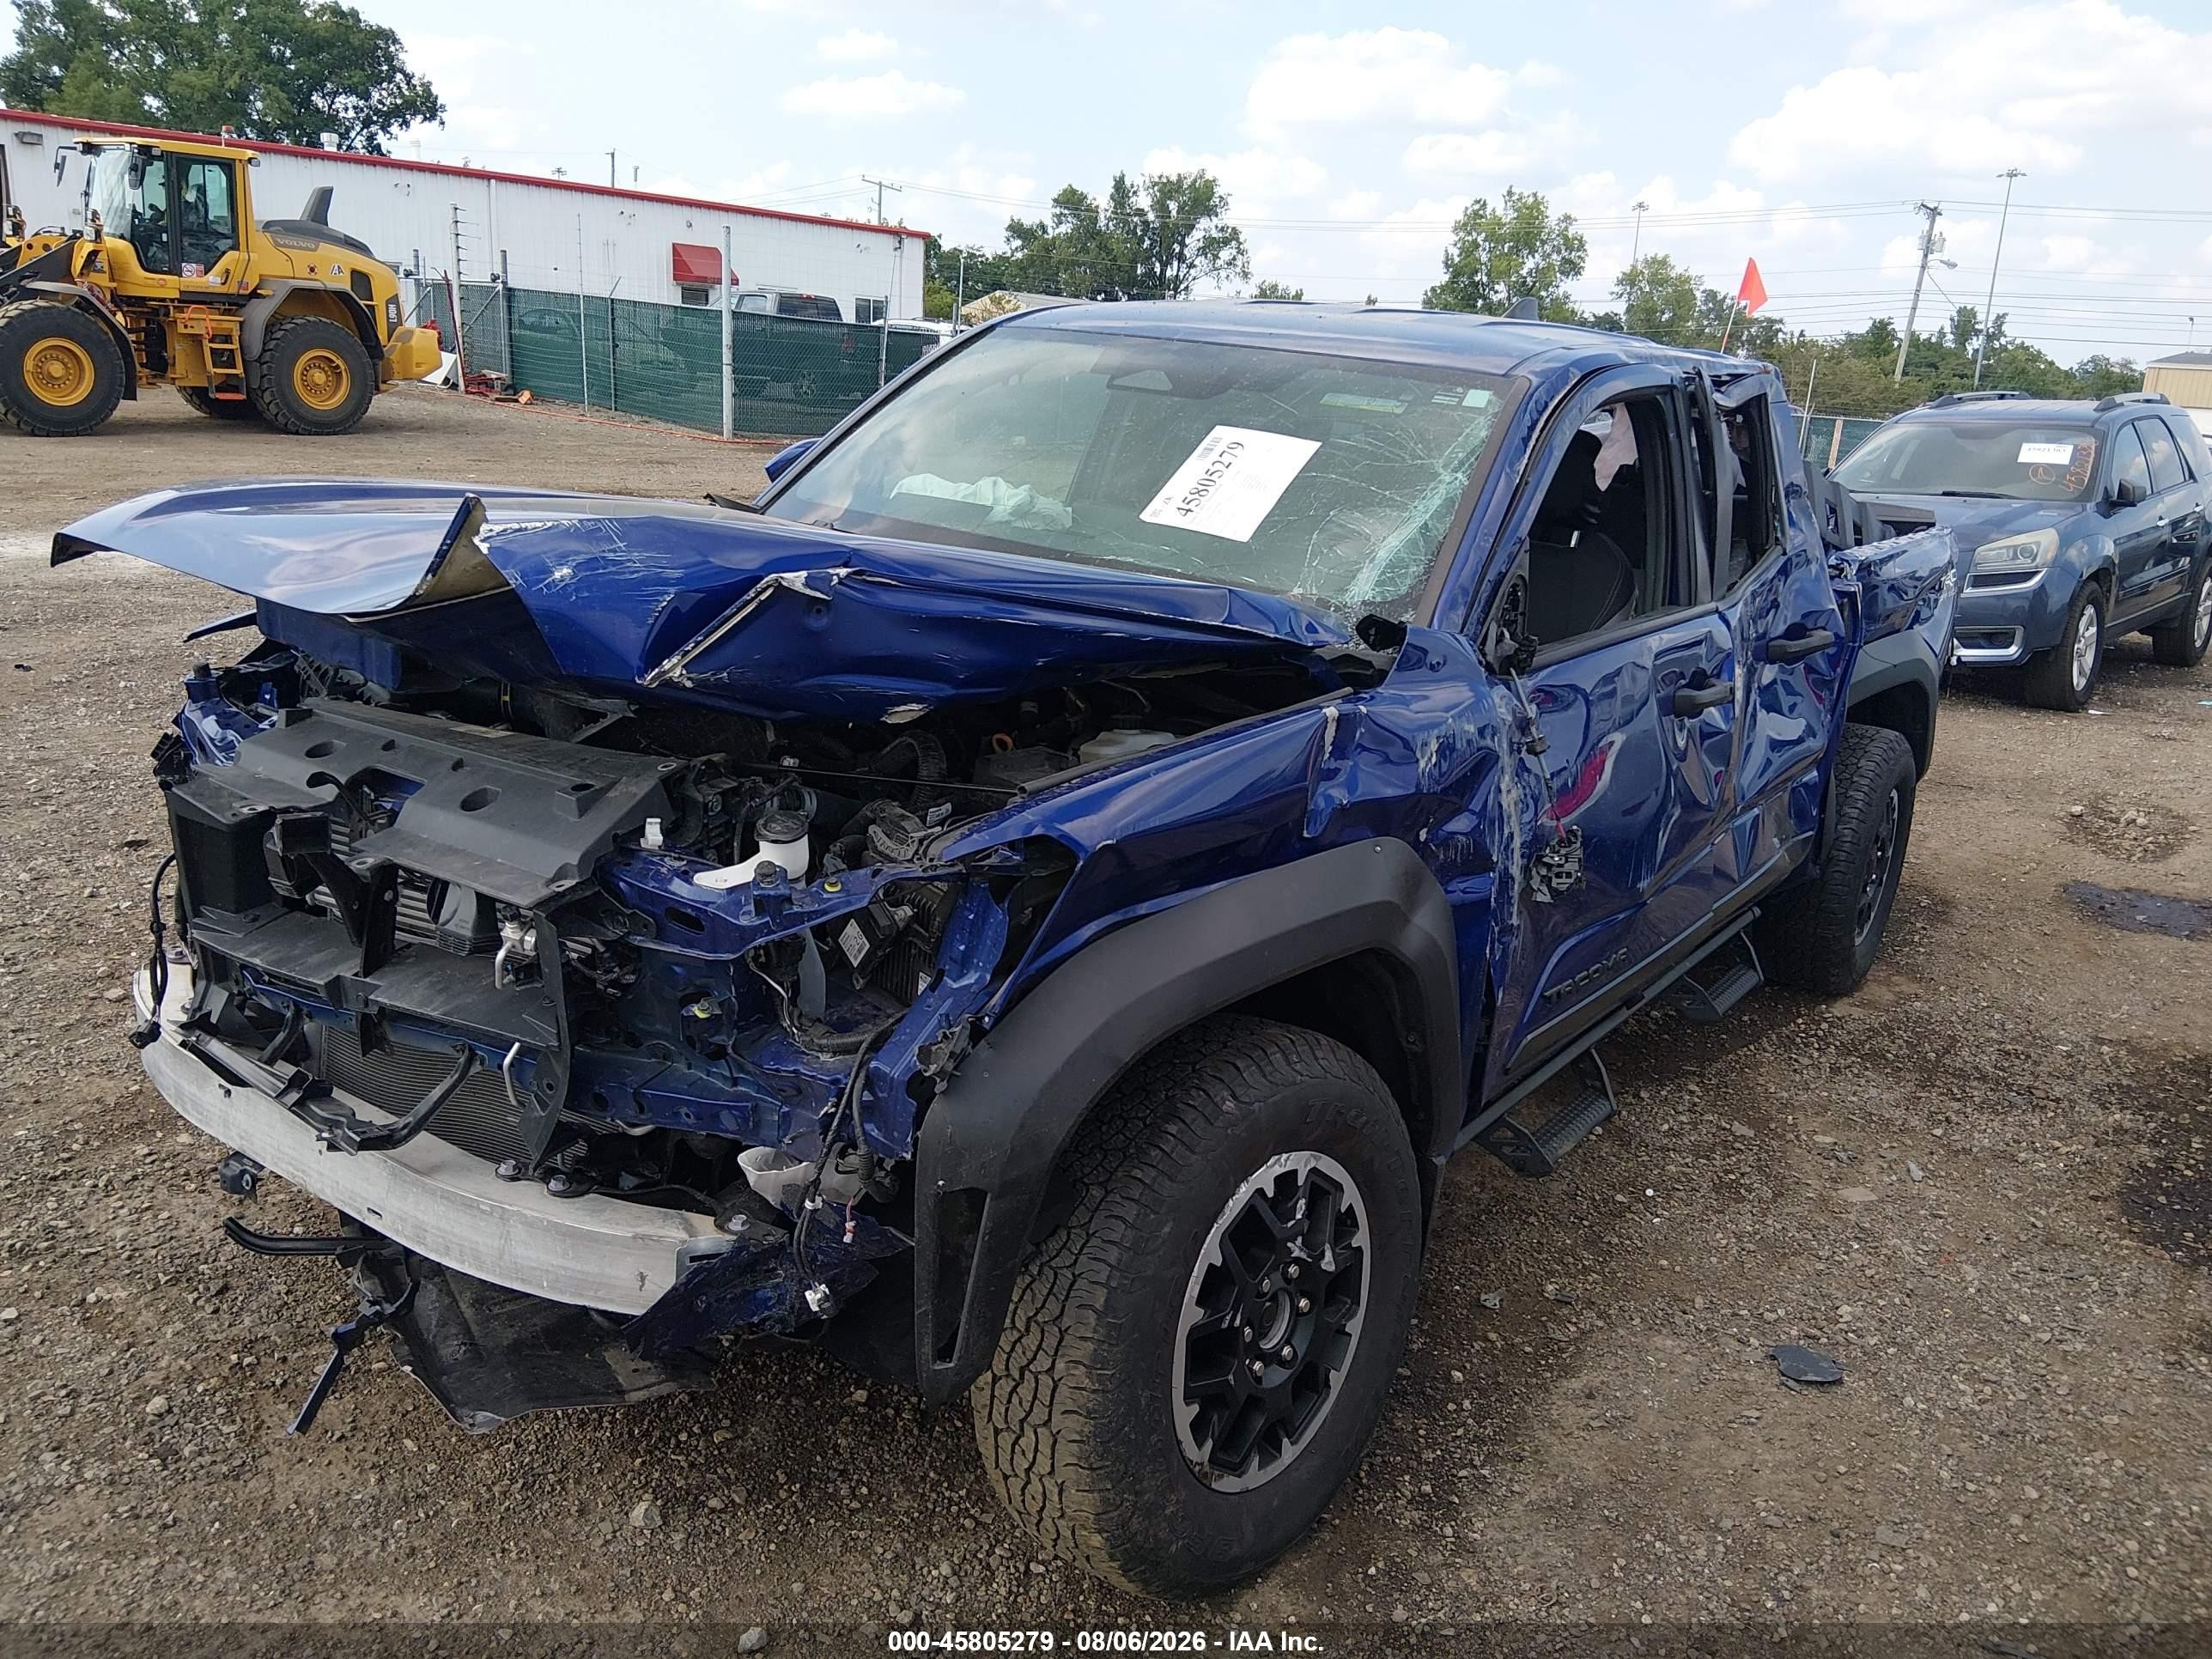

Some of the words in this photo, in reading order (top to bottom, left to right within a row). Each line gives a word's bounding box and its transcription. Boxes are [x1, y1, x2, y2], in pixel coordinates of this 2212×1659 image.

[276, 239, 316, 249] VOLVO
[388, 304, 397, 323] L90H
[1176, 441, 1245, 519] 45805279
[1542, 947, 1629, 1003] TACOMA
